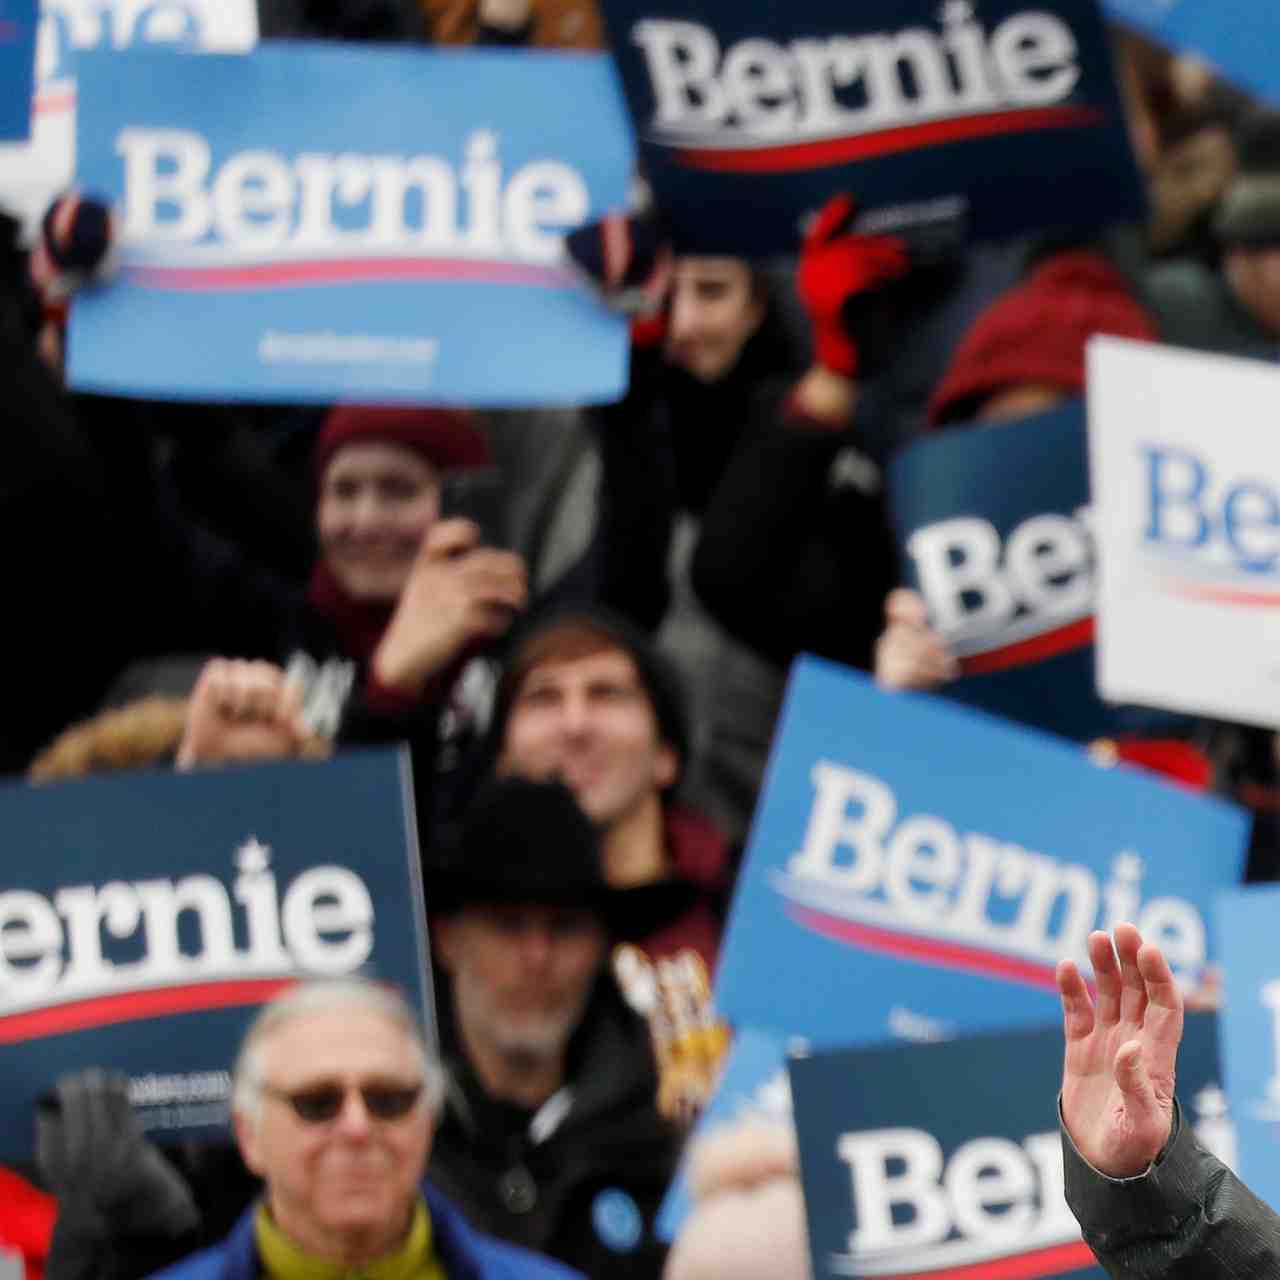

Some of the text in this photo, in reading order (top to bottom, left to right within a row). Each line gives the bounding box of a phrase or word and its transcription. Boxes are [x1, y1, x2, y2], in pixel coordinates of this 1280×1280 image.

[632, 0, 1079, 135] Bernie
[116, 129, 590, 258] Bernie
[0, 836, 376, 1000] ernie
[787, 758, 1206, 992] Bernie
